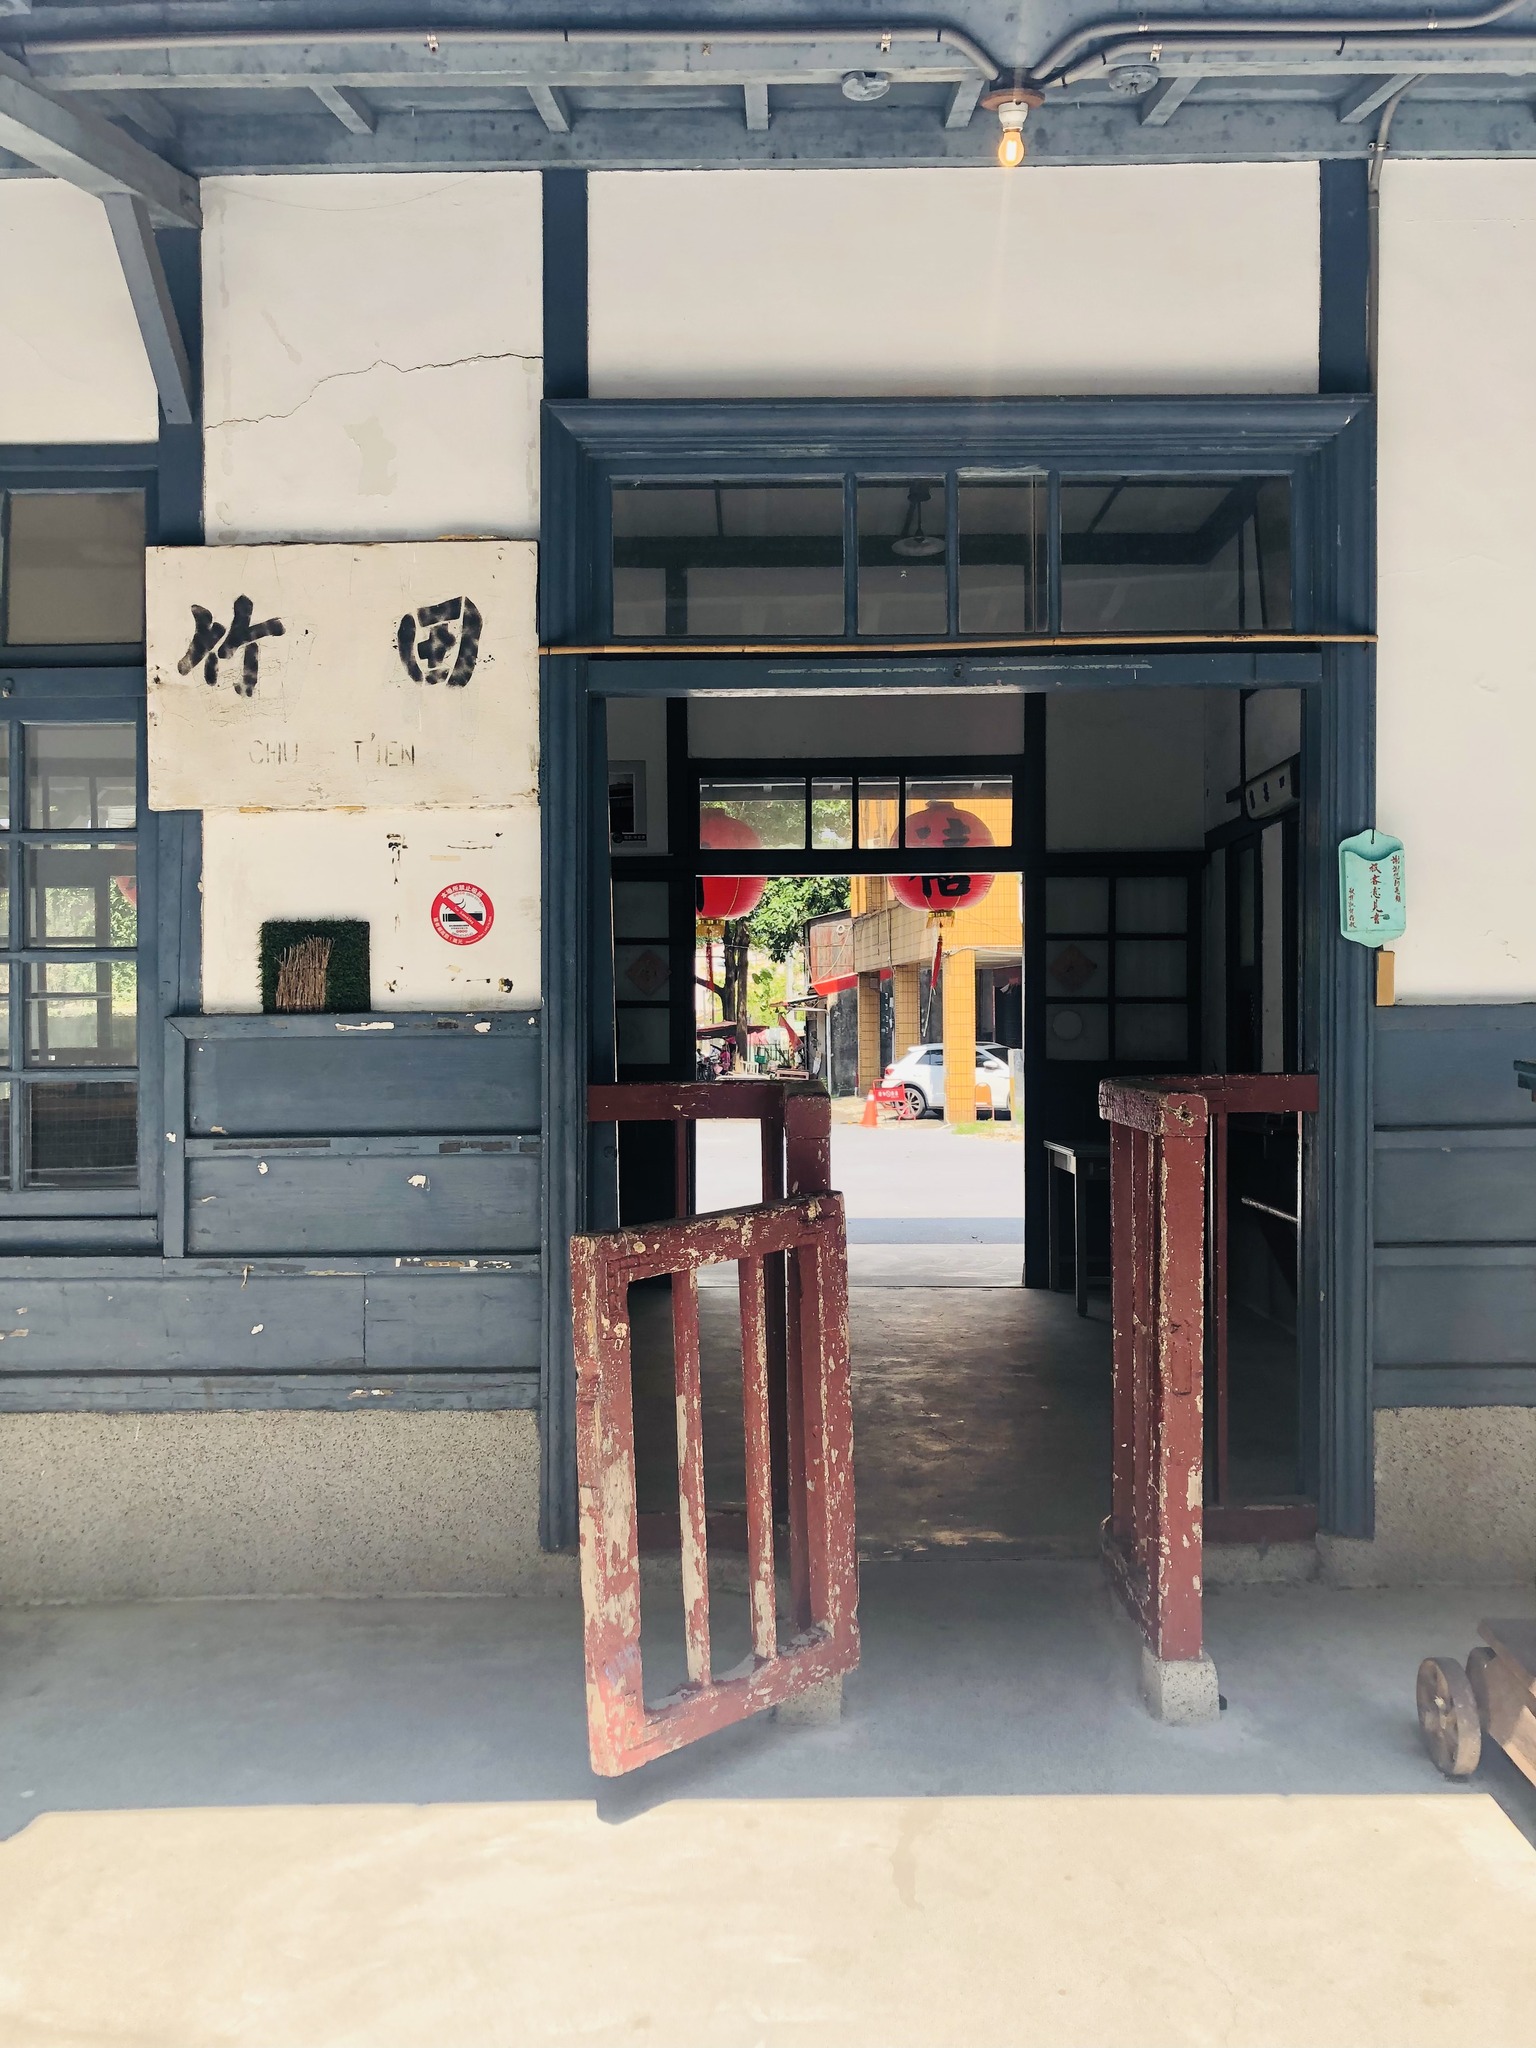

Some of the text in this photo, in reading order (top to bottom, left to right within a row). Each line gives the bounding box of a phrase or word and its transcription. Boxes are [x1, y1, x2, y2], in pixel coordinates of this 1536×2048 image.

[177, 594, 483, 697] 竹 田
[249, 739, 299, 765] CHU
